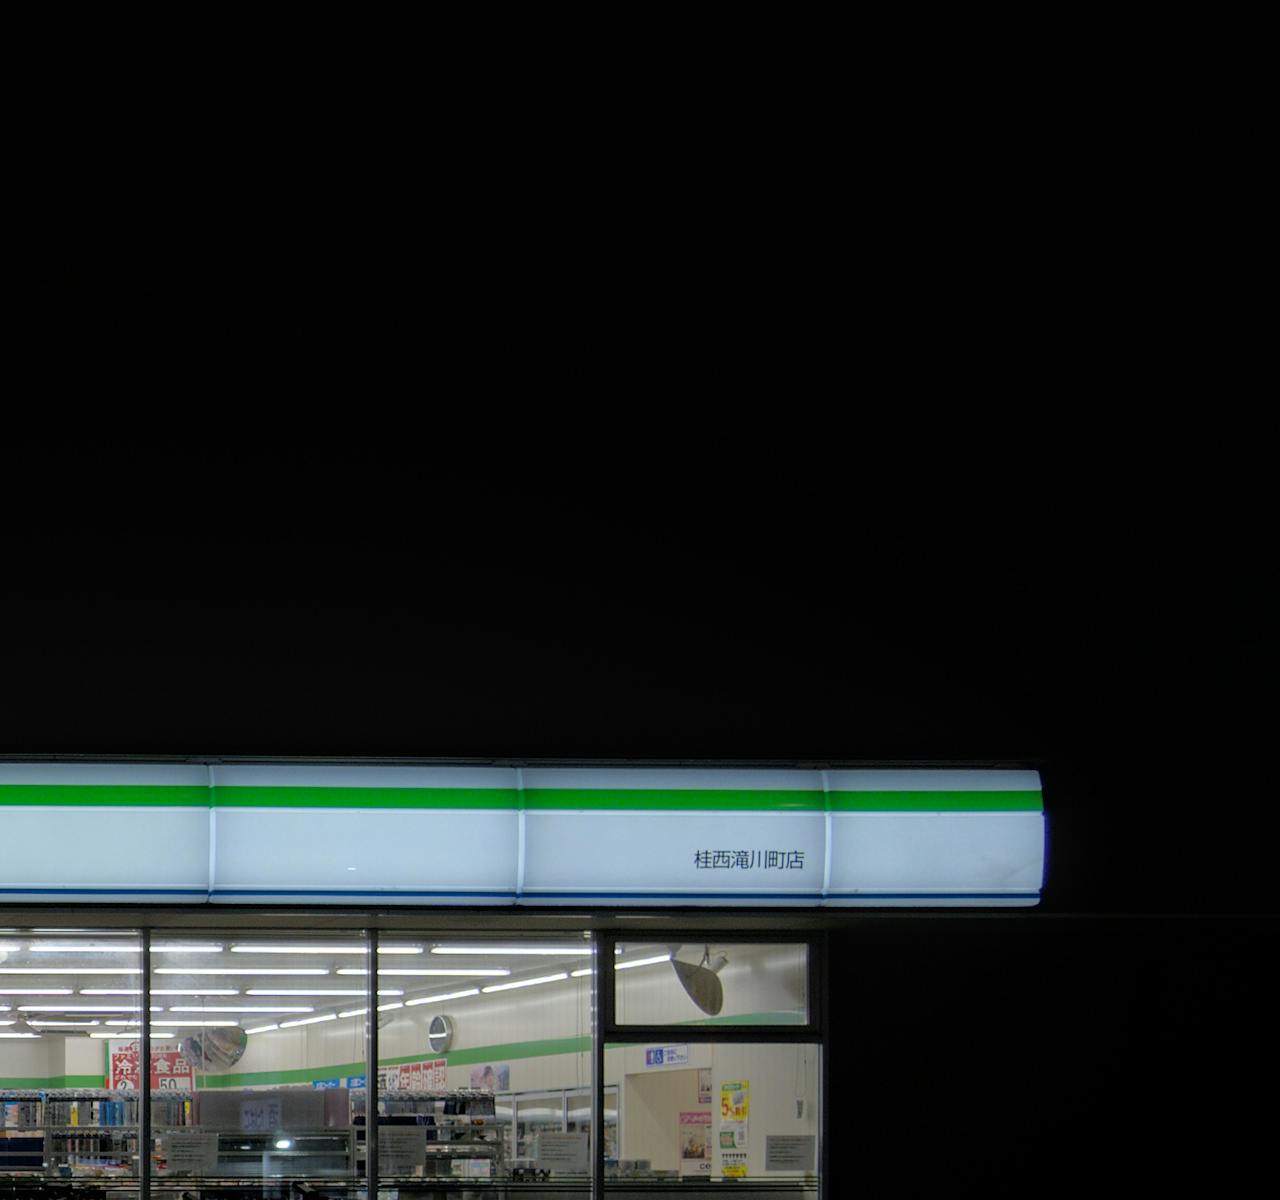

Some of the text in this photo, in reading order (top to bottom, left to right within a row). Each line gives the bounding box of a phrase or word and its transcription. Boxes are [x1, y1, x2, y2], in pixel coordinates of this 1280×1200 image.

[694, 850, 805, 870] 桂西滝川町店
[115, 1059, 190, 1075] 冷食品
